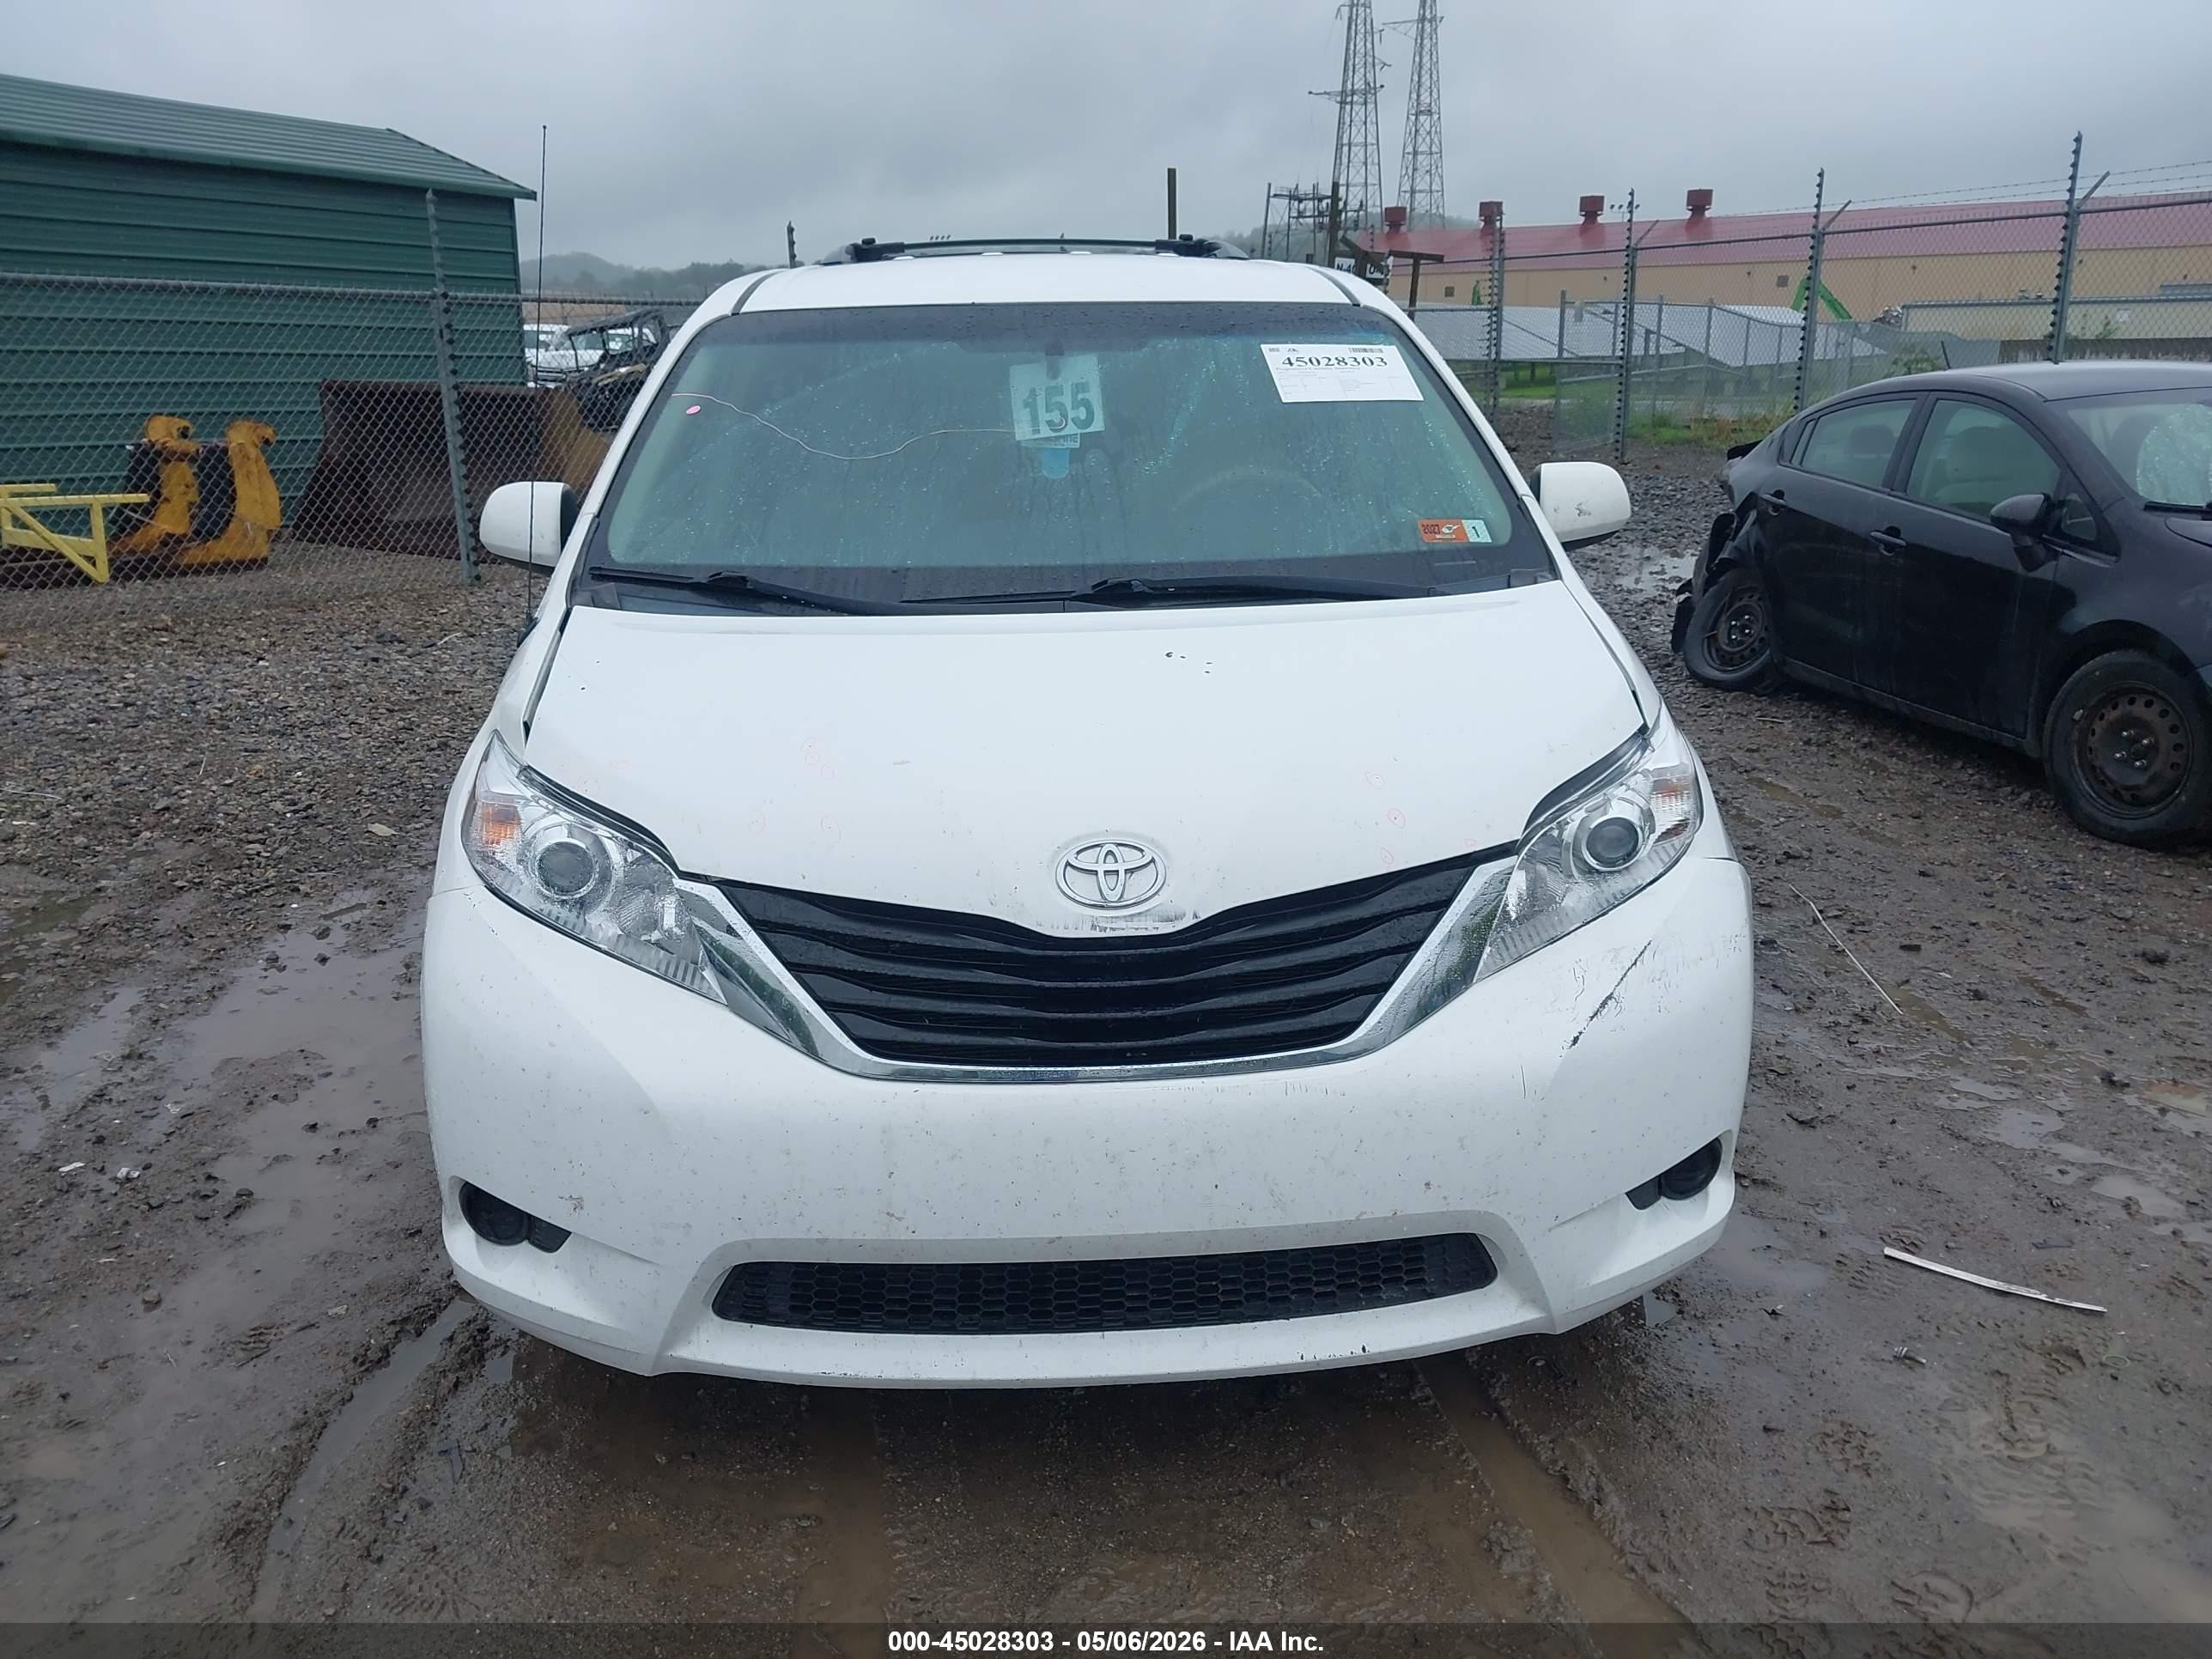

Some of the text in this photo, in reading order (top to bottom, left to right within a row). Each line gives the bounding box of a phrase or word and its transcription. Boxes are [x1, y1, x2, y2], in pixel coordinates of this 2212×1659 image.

[1282, 356, 1388, 368] 45028303
[1022, 381, 1095, 435] 155
[1471, 526, 1480, 538] 1
